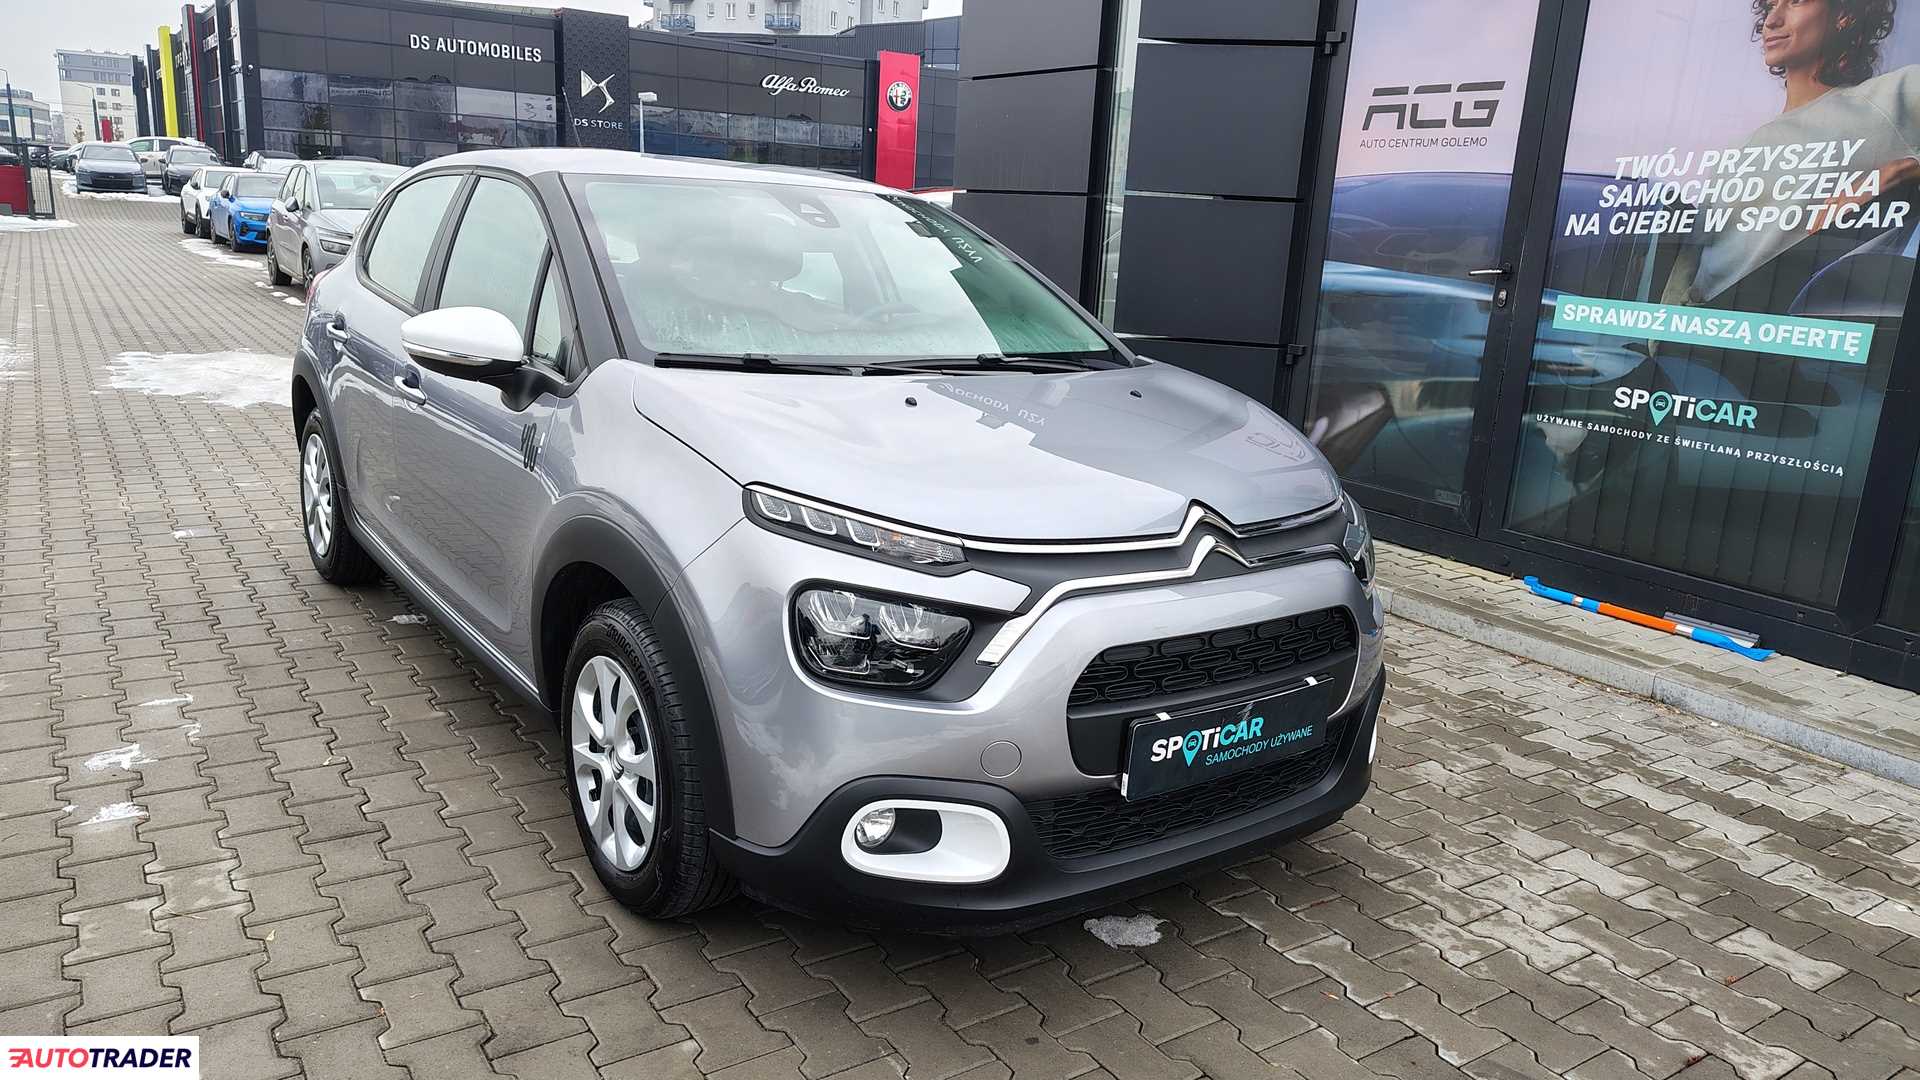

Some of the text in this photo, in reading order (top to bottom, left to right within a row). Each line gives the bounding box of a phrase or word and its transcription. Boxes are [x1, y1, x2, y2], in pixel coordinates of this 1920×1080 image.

[410, 34, 542, 63] DS AUTOMOBILES
[761, 74, 850, 97] Alfa Romeo
[574, 118, 624, 130] DS STORE
[1362, 80, 1506, 131] ACG
[1360, 136, 1488, 149] AUTO CENTRUM GOLEMO
[1615, 138, 1866, 180] TWÓJ PRZYSZŁY
[1599, 169, 1881, 208] SAMOCHÓD CZEKA
[1564, 201, 1911, 237] NA CIEBIE W SPOTICAR
[1562, 303, 1863, 357] SPRAWDŹ NASZĄ OFERTĘ
[1536, 413, 1845, 477] UŻYWANE SAMOCHODY ZE ŚWIETLANĄ PRZYSZŁOŚCIĄ
[1205, 725, 1314, 766] SAMOCHODY UŻYWANE
